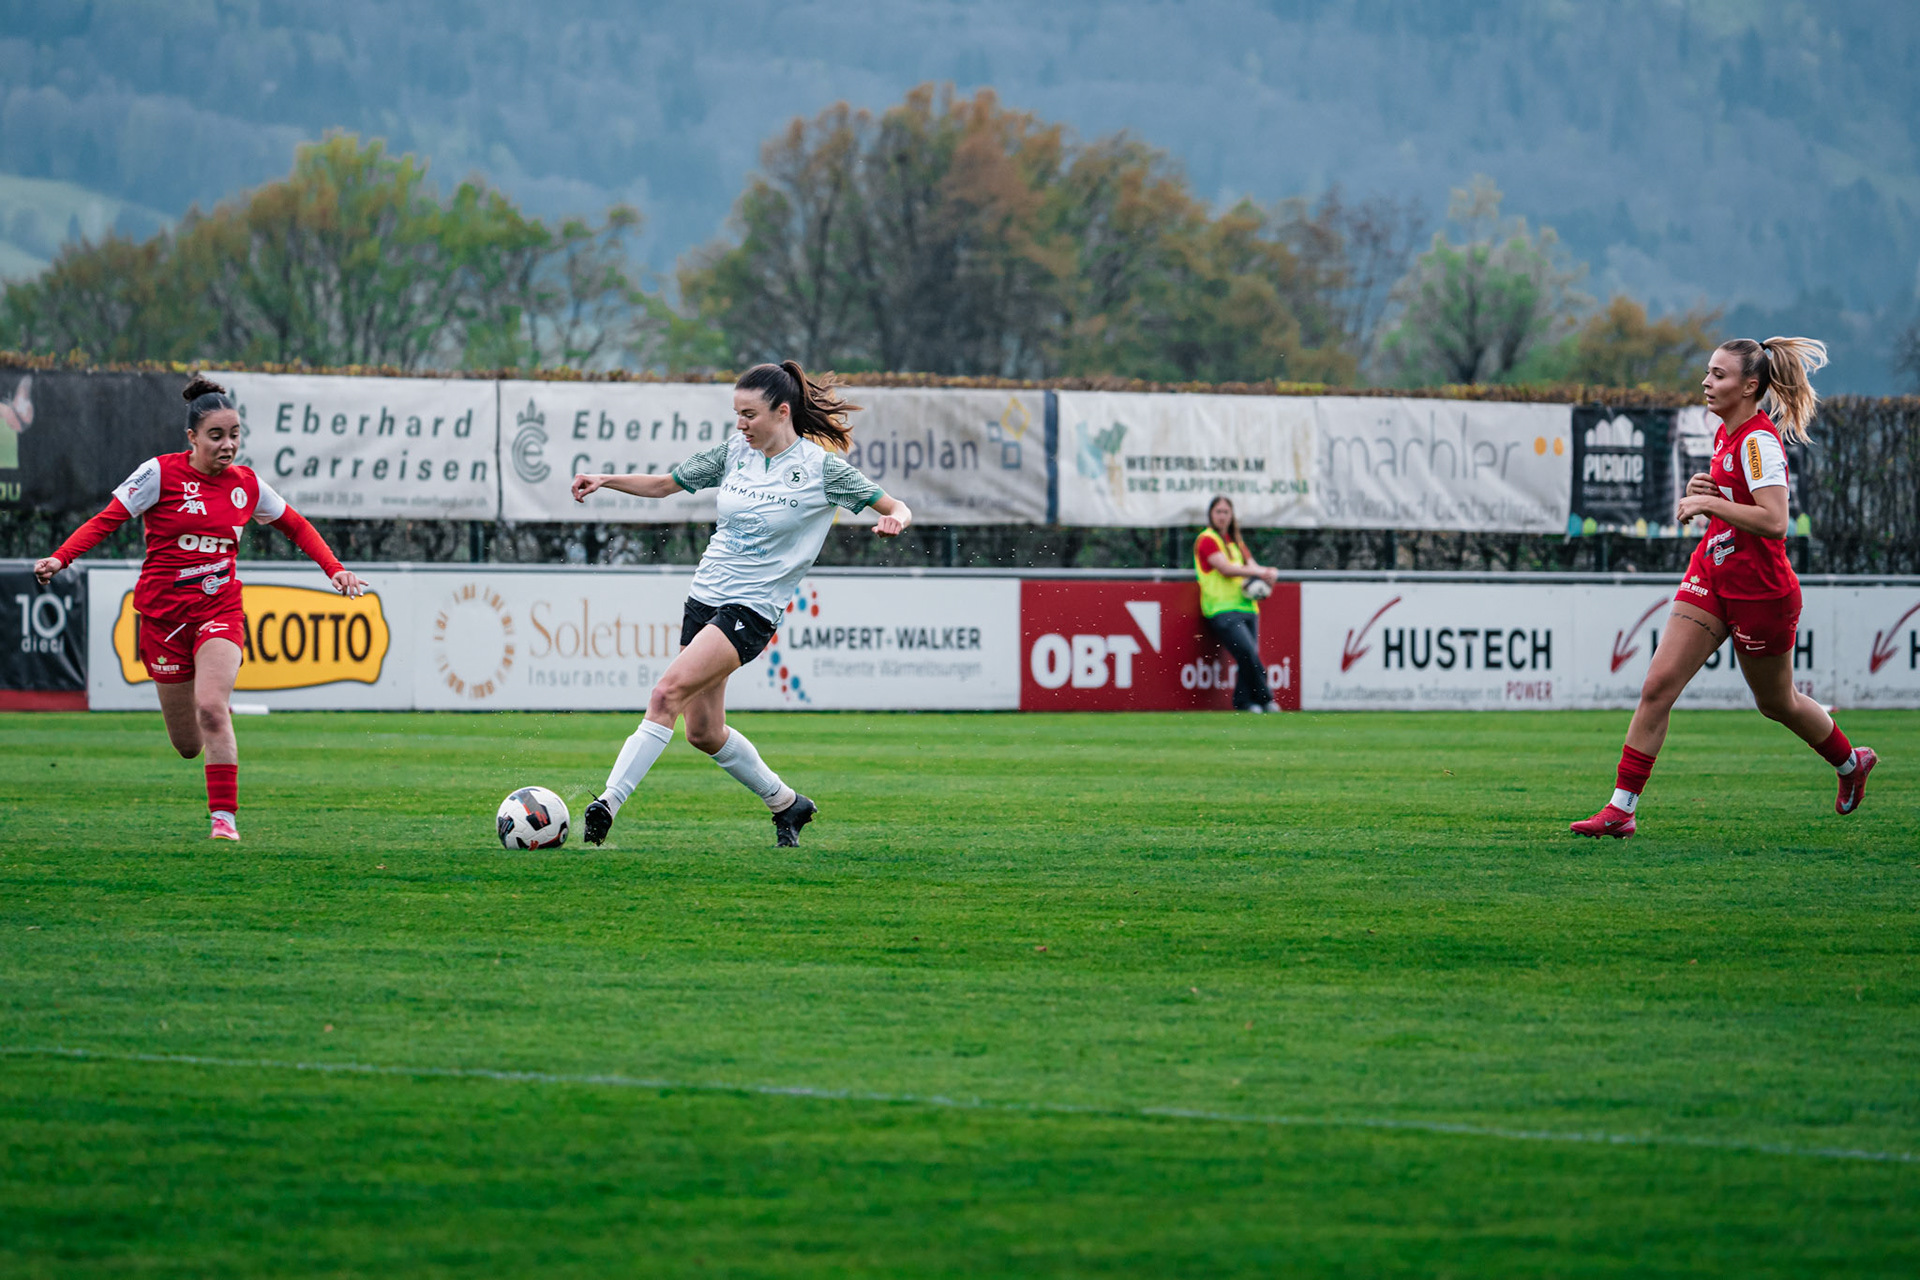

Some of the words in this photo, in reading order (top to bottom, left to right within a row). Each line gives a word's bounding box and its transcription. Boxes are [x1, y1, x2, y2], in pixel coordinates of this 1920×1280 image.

[275, 403, 473, 438] Eberhard
[572, 410, 734, 441] Eberhar
[1325, 410, 1521, 480] mächler
[274, 447, 488, 482] Carreisen
[1126, 455, 1239, 472] WEITERBILDEN
[1243, 456, 1266, 472] AM
[177, 499, 208, 516] AXA
[178, 533, 234, 553] OBT
[21, 635, 65, 654] dieci
[1383, 628, 1553, 670] HUSTECH
[1030, 632, 1142, 689] OBT
[528, 665, 629, 687] Insurance
[1505, 681, 1553, 701] POWER
